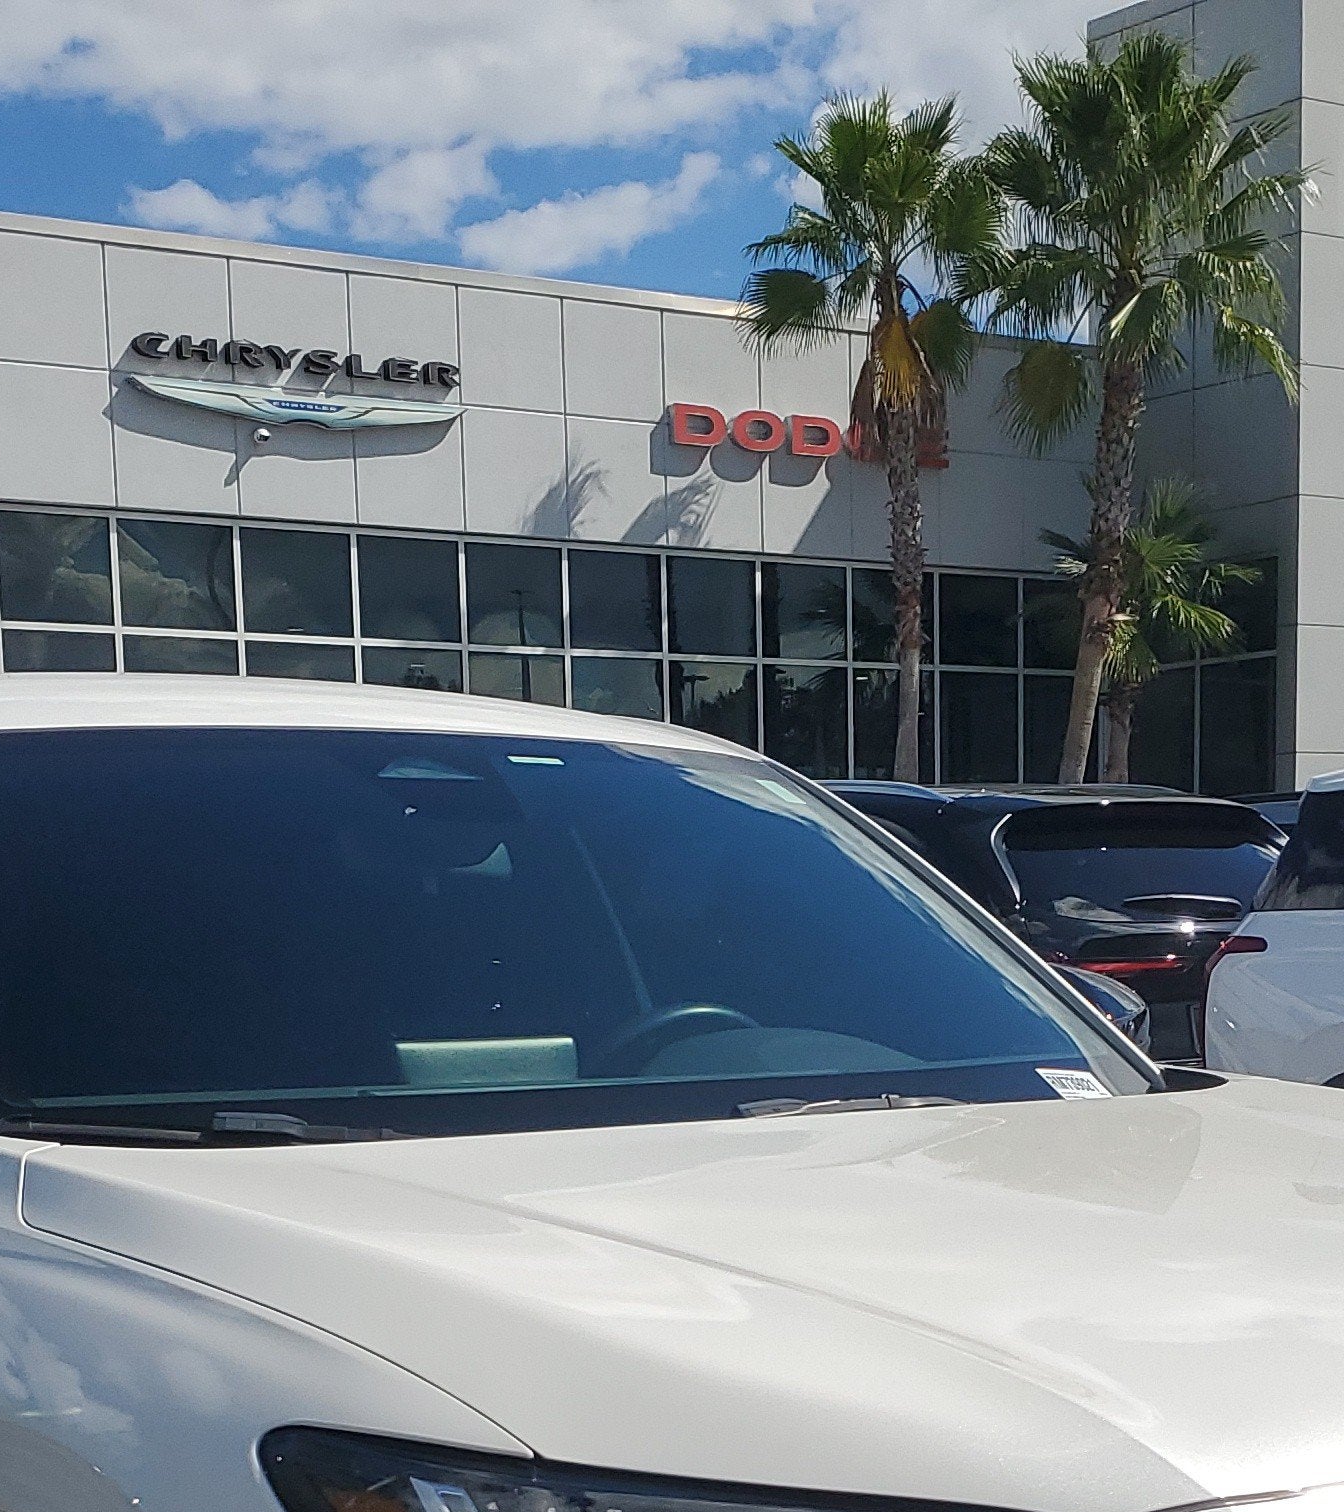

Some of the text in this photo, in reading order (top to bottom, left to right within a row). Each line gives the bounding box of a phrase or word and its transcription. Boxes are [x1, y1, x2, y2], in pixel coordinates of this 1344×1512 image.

[131, 331, 460, 388] CHRYSLER
[272, 400, 338, 412] CHRYSLER
[668, 402, 949, 468] DOD
